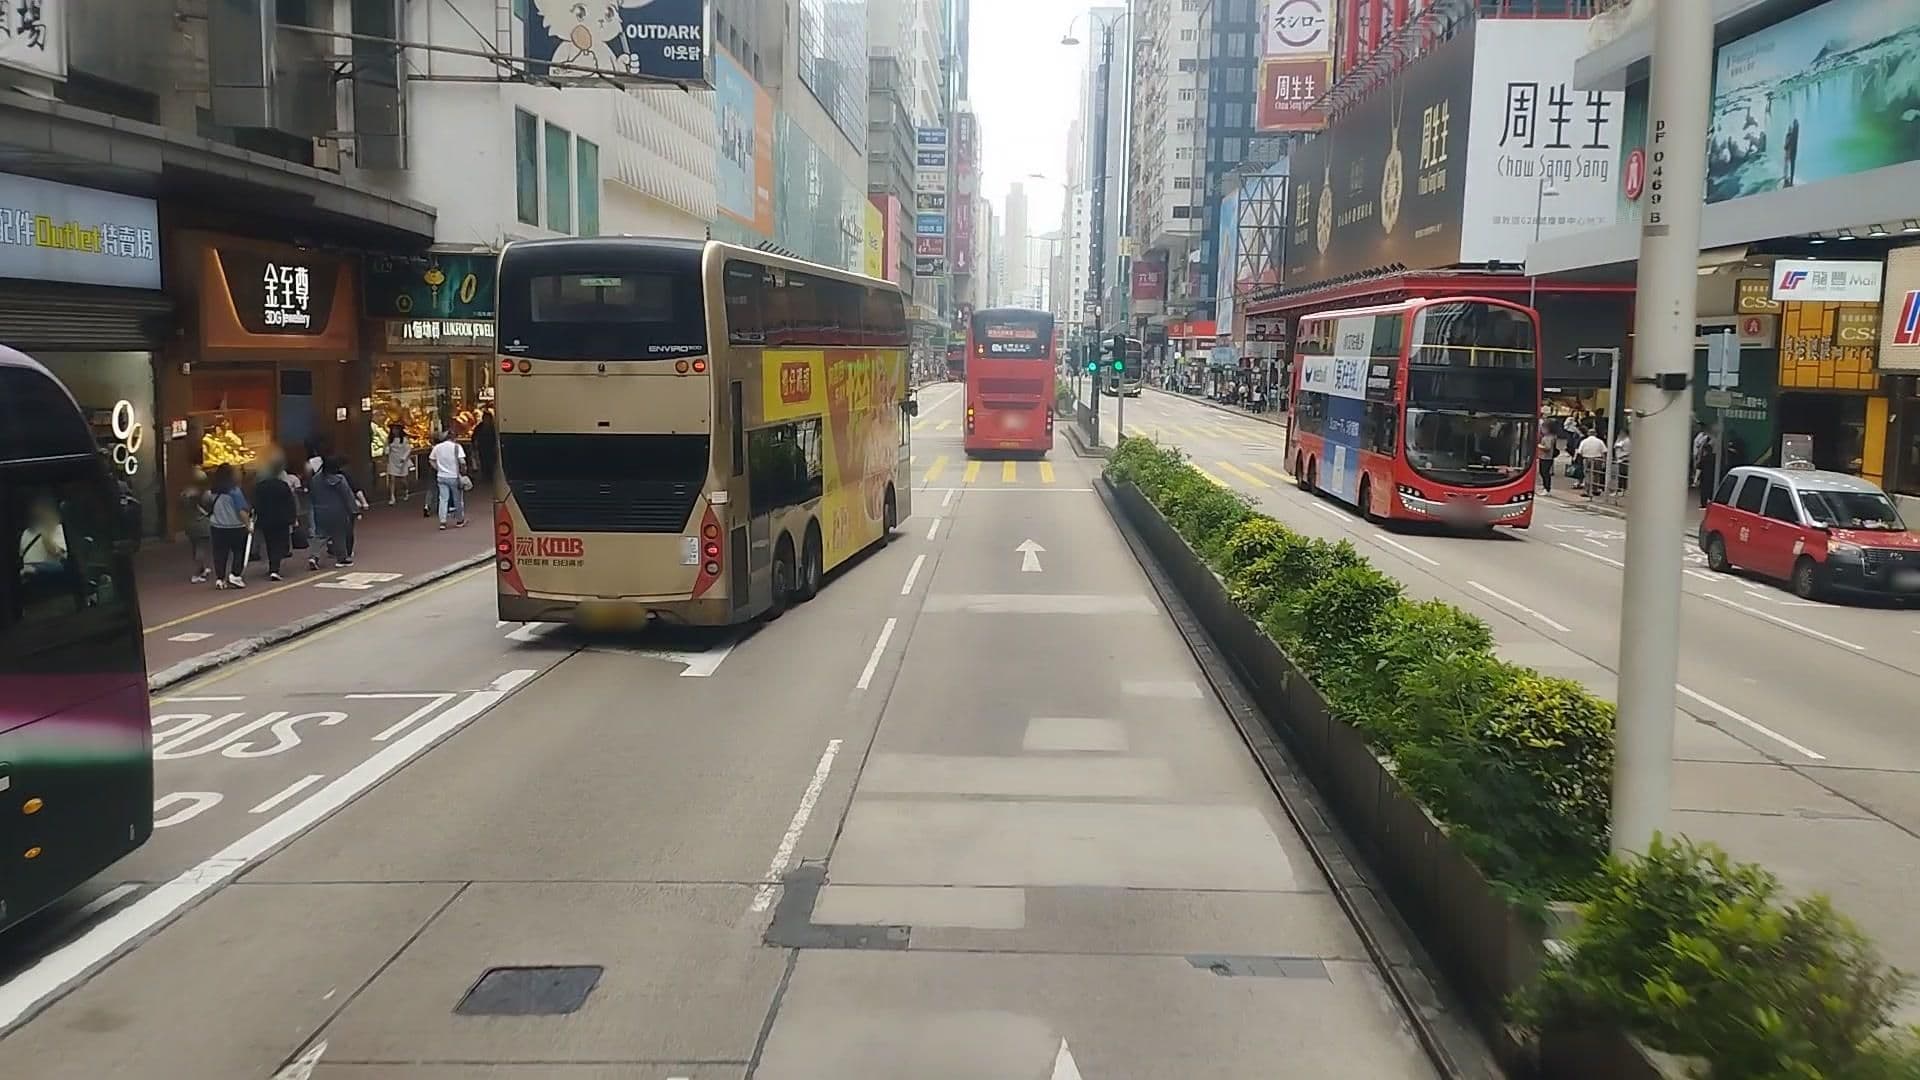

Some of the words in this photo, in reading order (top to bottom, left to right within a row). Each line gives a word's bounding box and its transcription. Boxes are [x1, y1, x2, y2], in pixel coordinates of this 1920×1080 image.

[0, 0, 47, 51] 場
[626, 24, 700, 39] OUTDARK
[1273, 15, 1325, 29] スシロー
[663, 45, 700, 60] 아웃닭
[1275, 75, 1315, 100] 周生生
[1498, 82, 1611, 149] 周生生
[1419, 98, 1450, 169] 周生生
[1497, 154, 1534, 177] Chow
[1538, 154, 1571, 183] Sang
[1576, 154, 1608, 182] Sang
[264, 262, 310, 310] 金至尊
[1849, 272, 1878, 286] Mall
[264, 310, 281, 324] 3DG
[536, 537, 584, 557] KMB
